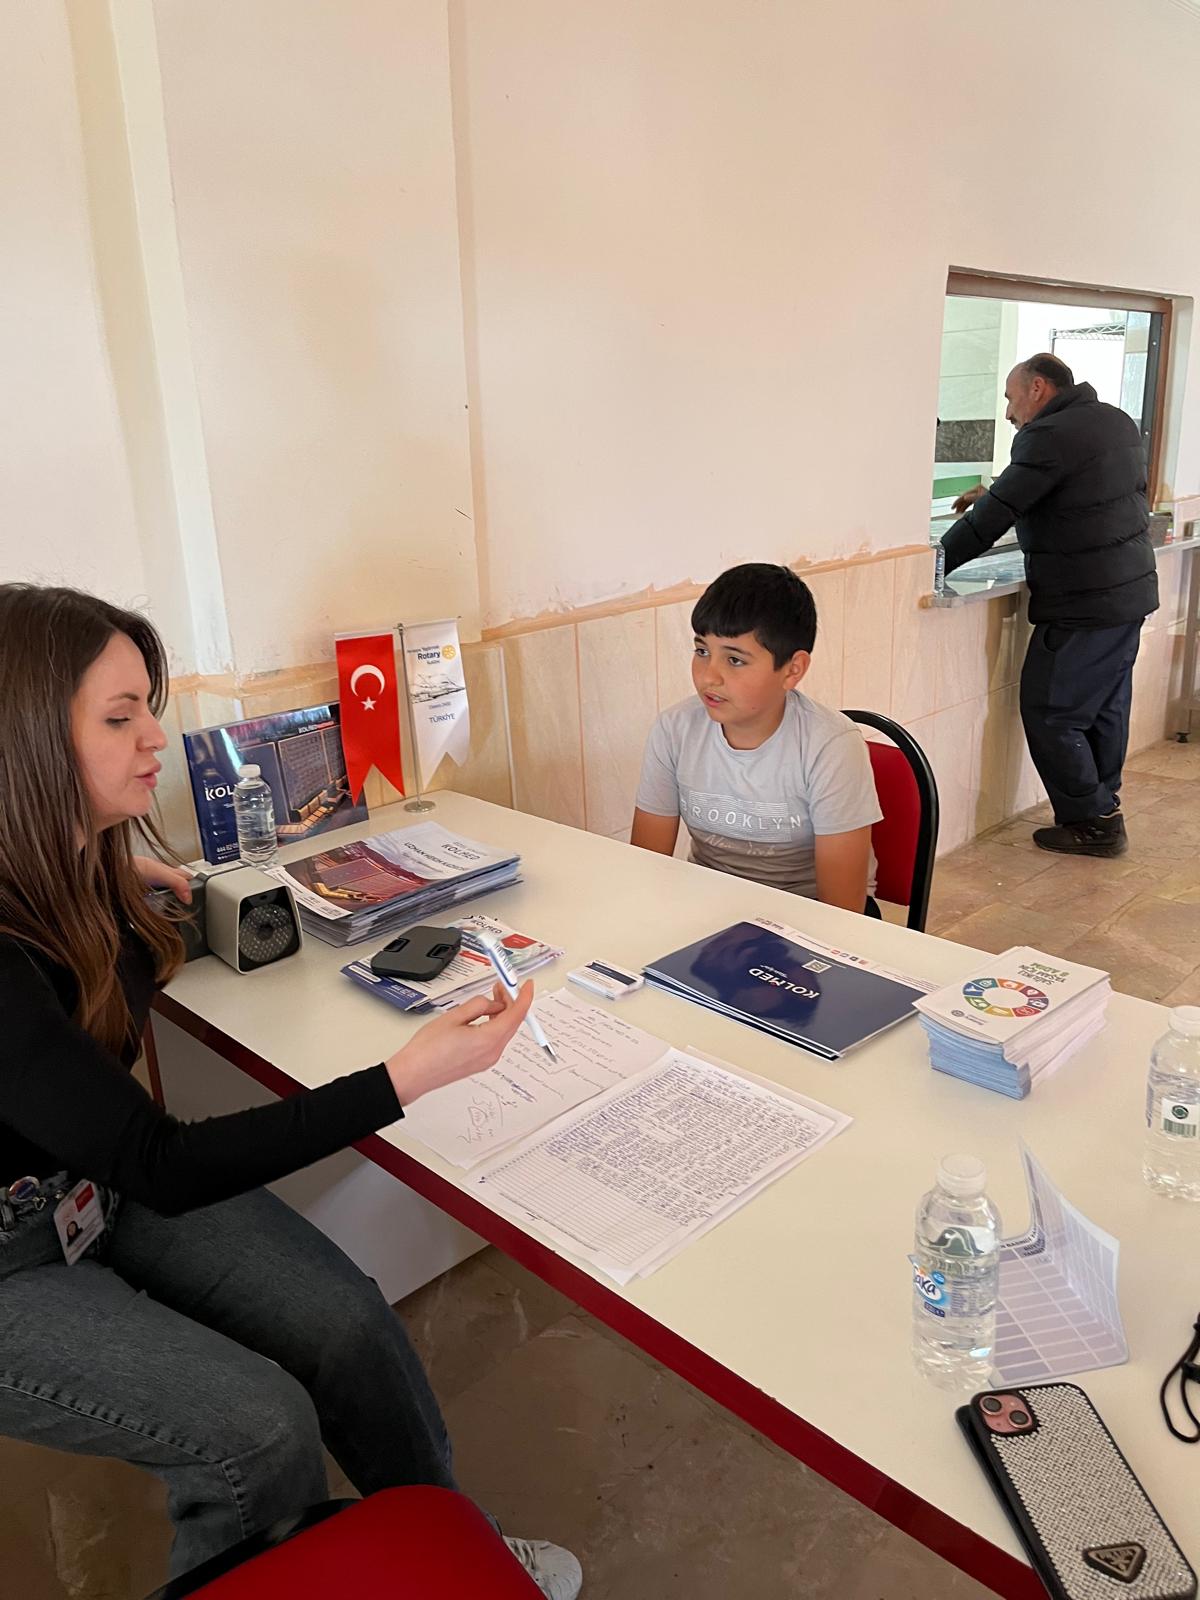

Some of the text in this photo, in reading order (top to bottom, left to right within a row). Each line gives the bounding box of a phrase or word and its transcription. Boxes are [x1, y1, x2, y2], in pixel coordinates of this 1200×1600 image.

[417, 651, 441, 661] Rotary
[428, 712, 455, 723] TÜRKİYE
[204, 783, 236, 801] KOL
[680, 798, 801, 830] BROOKLYN
[441, 843, 480, 860] KOLMED
[471, 919, 503, 934] KOLMED
[748, 967, 820, 999] KOLMED
